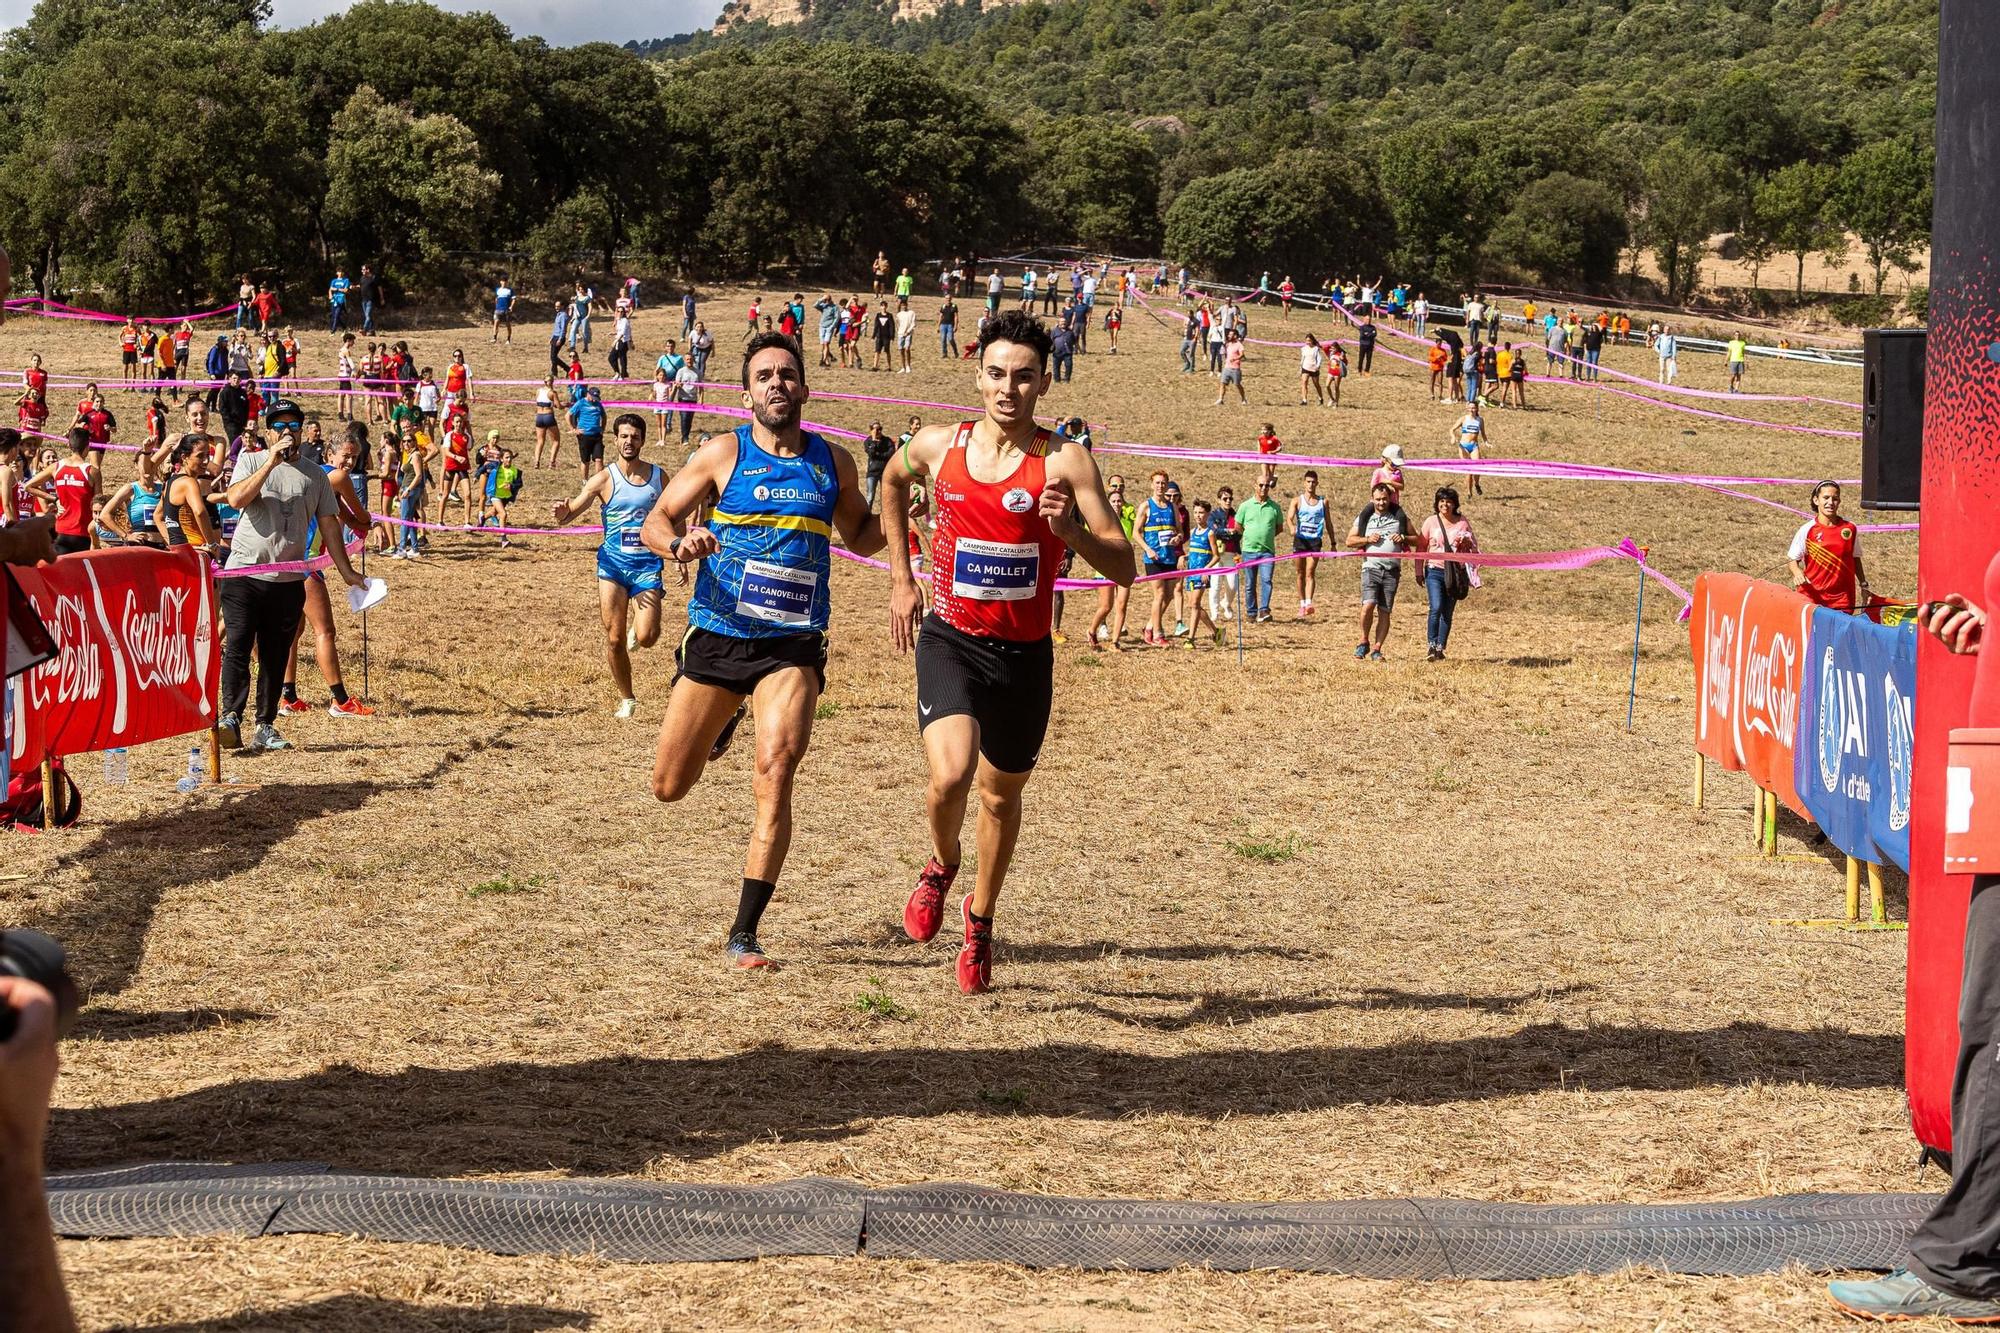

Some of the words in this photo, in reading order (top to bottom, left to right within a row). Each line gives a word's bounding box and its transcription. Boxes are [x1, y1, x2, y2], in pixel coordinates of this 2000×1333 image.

[771, 488, 826, 504] GEOLimits
[963, 542, 998, 552] CAMPIONAT
[751, 565, 783, 576] CAMPIONAT
[967, 563, 981, 573] CA
[984, 565, 1027, 576] MOLLET
[748, 583, 759, 593] CA
[760, 586, 809, 602] CANOVELLES
[122, 586, 191, 691] Coca-Cola
[1743, 625, 1796, 750] Coca-Cola
[1848, 772, 1871, 802] d'atle
